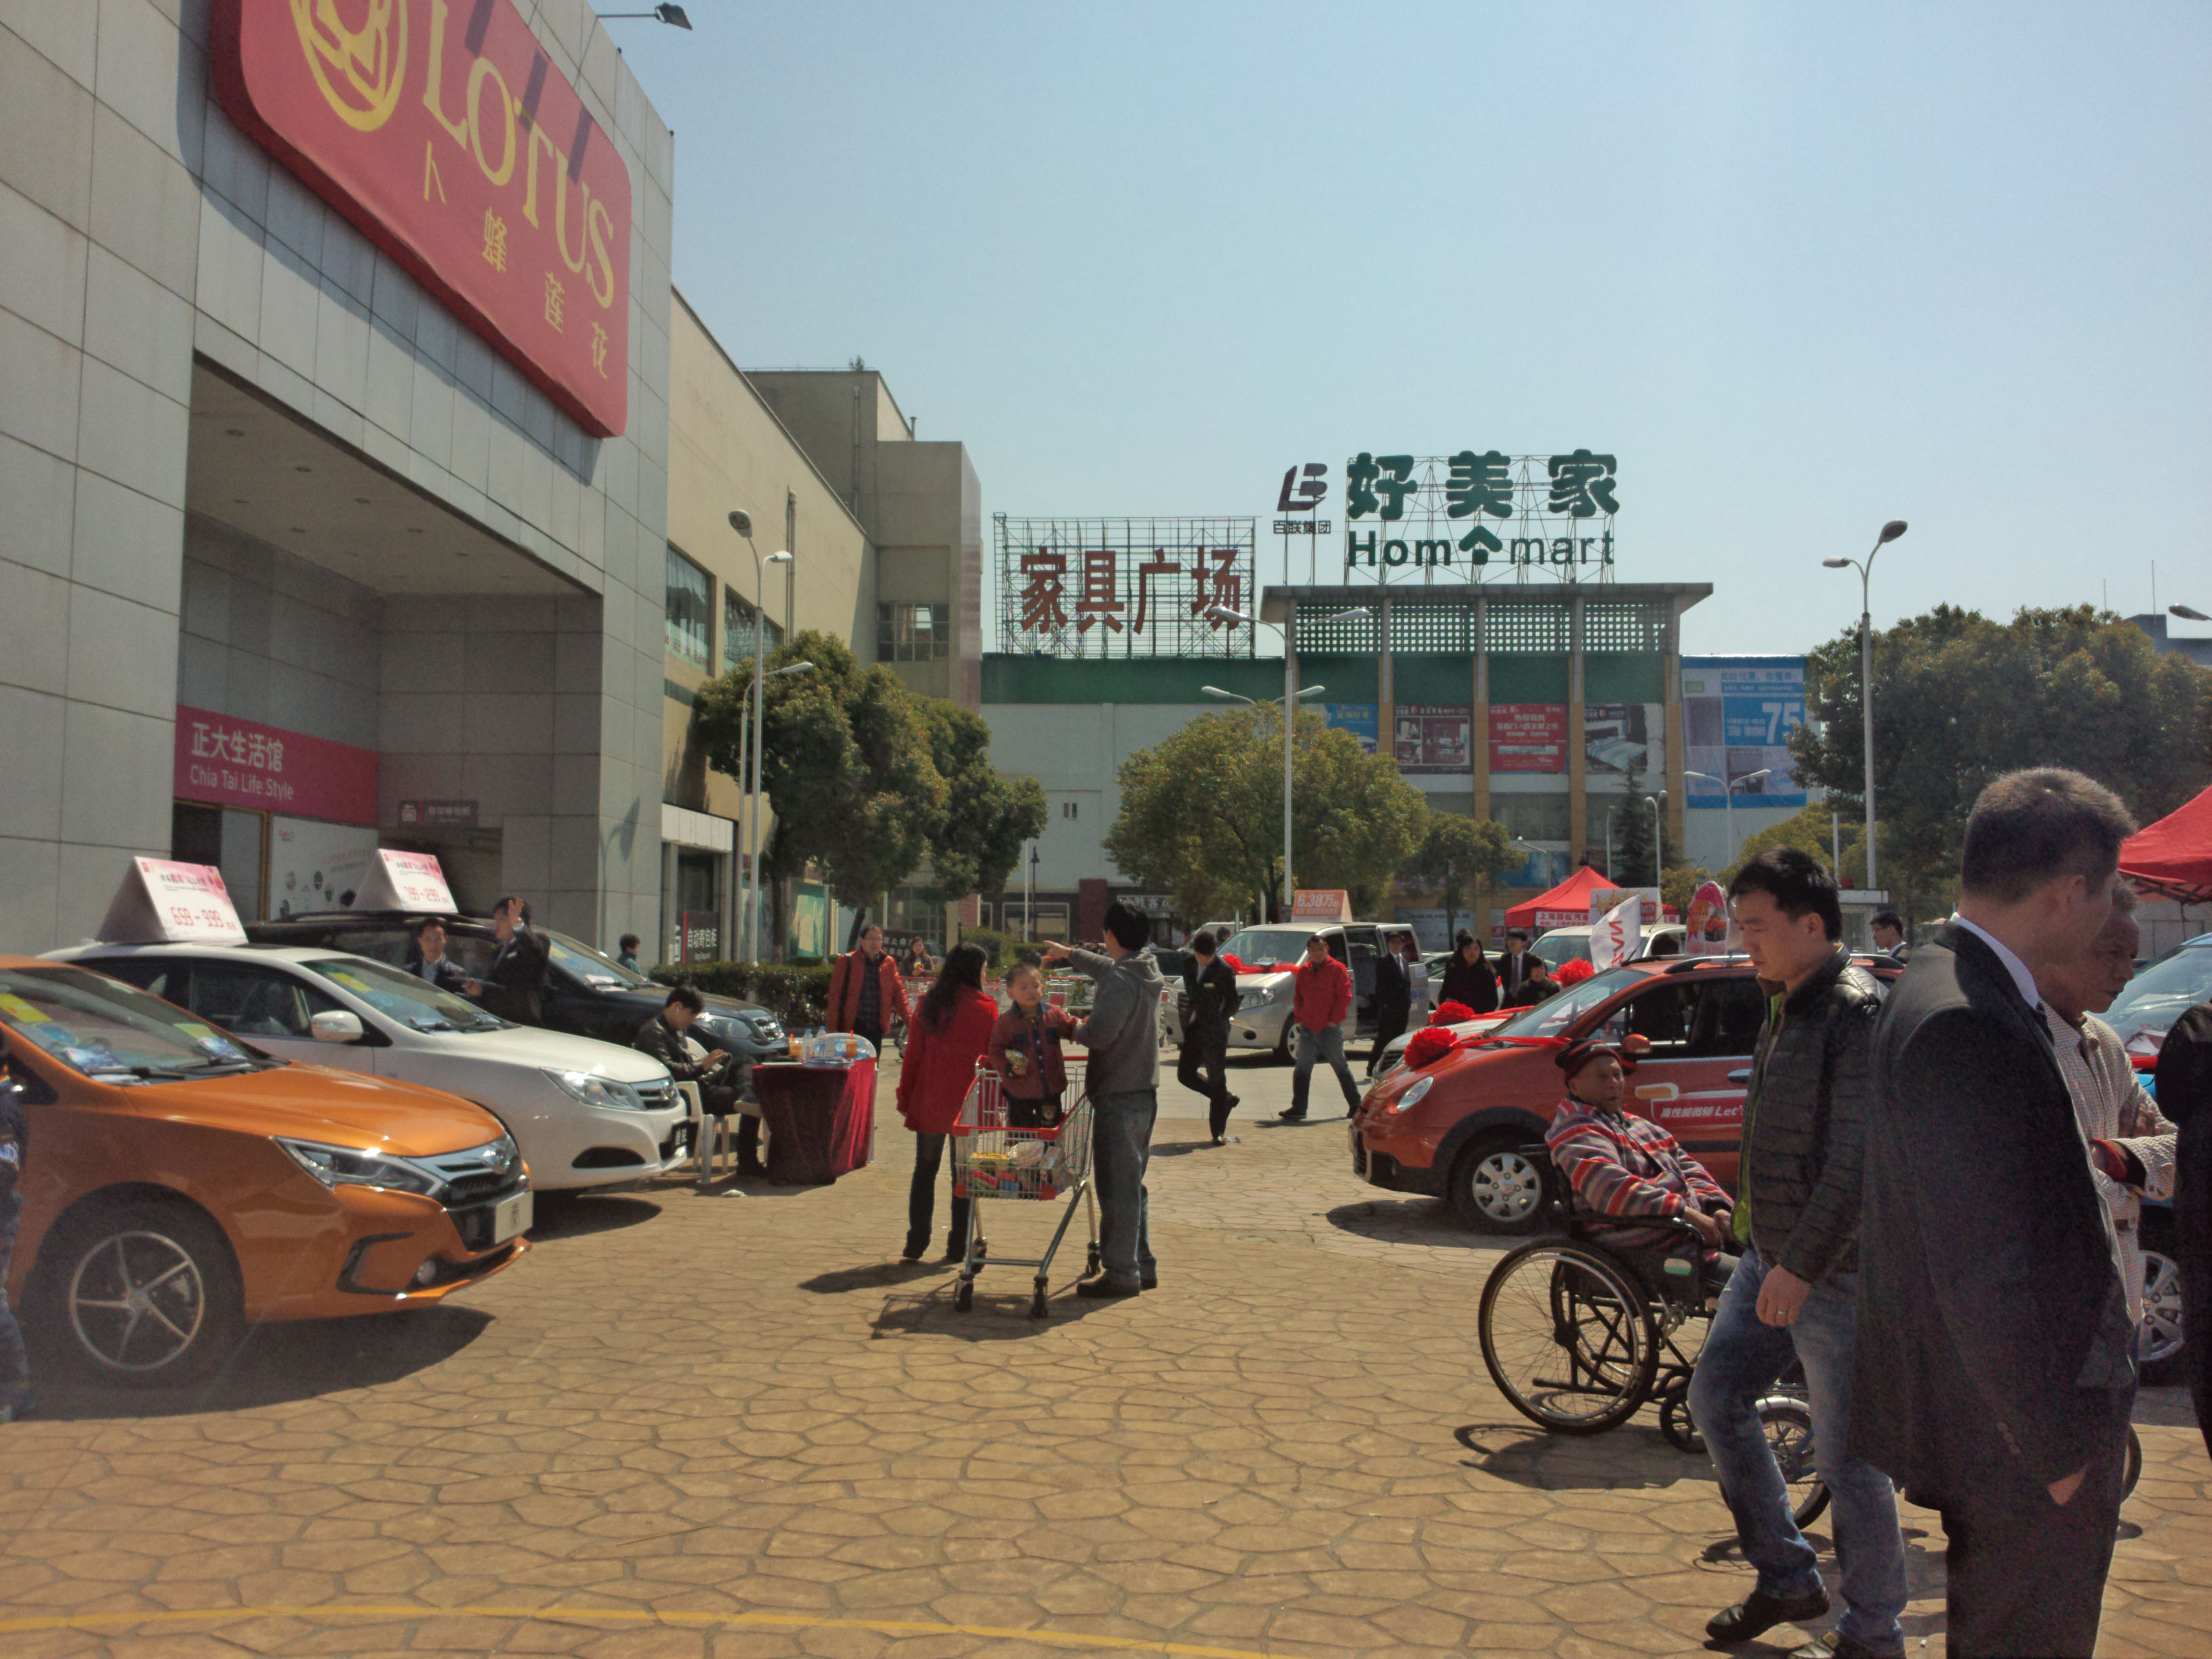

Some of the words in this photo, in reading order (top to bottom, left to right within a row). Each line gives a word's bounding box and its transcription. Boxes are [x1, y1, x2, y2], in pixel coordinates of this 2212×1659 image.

[424, 0, 613, 308] LOTUS
[1347, 449, 1620, 520] 好美家
[1273, 520, 1331, 534] 百联集团
[1020, 546, 1241, 634] 家具广场
[191, 722, 284, 773] 正大生活馆
[190, 764, 218, 787] Chia
[222, 769, 238, 790] Tai
[241, 773, 263, 795] Life
[266, 777, 293, 801] Style
